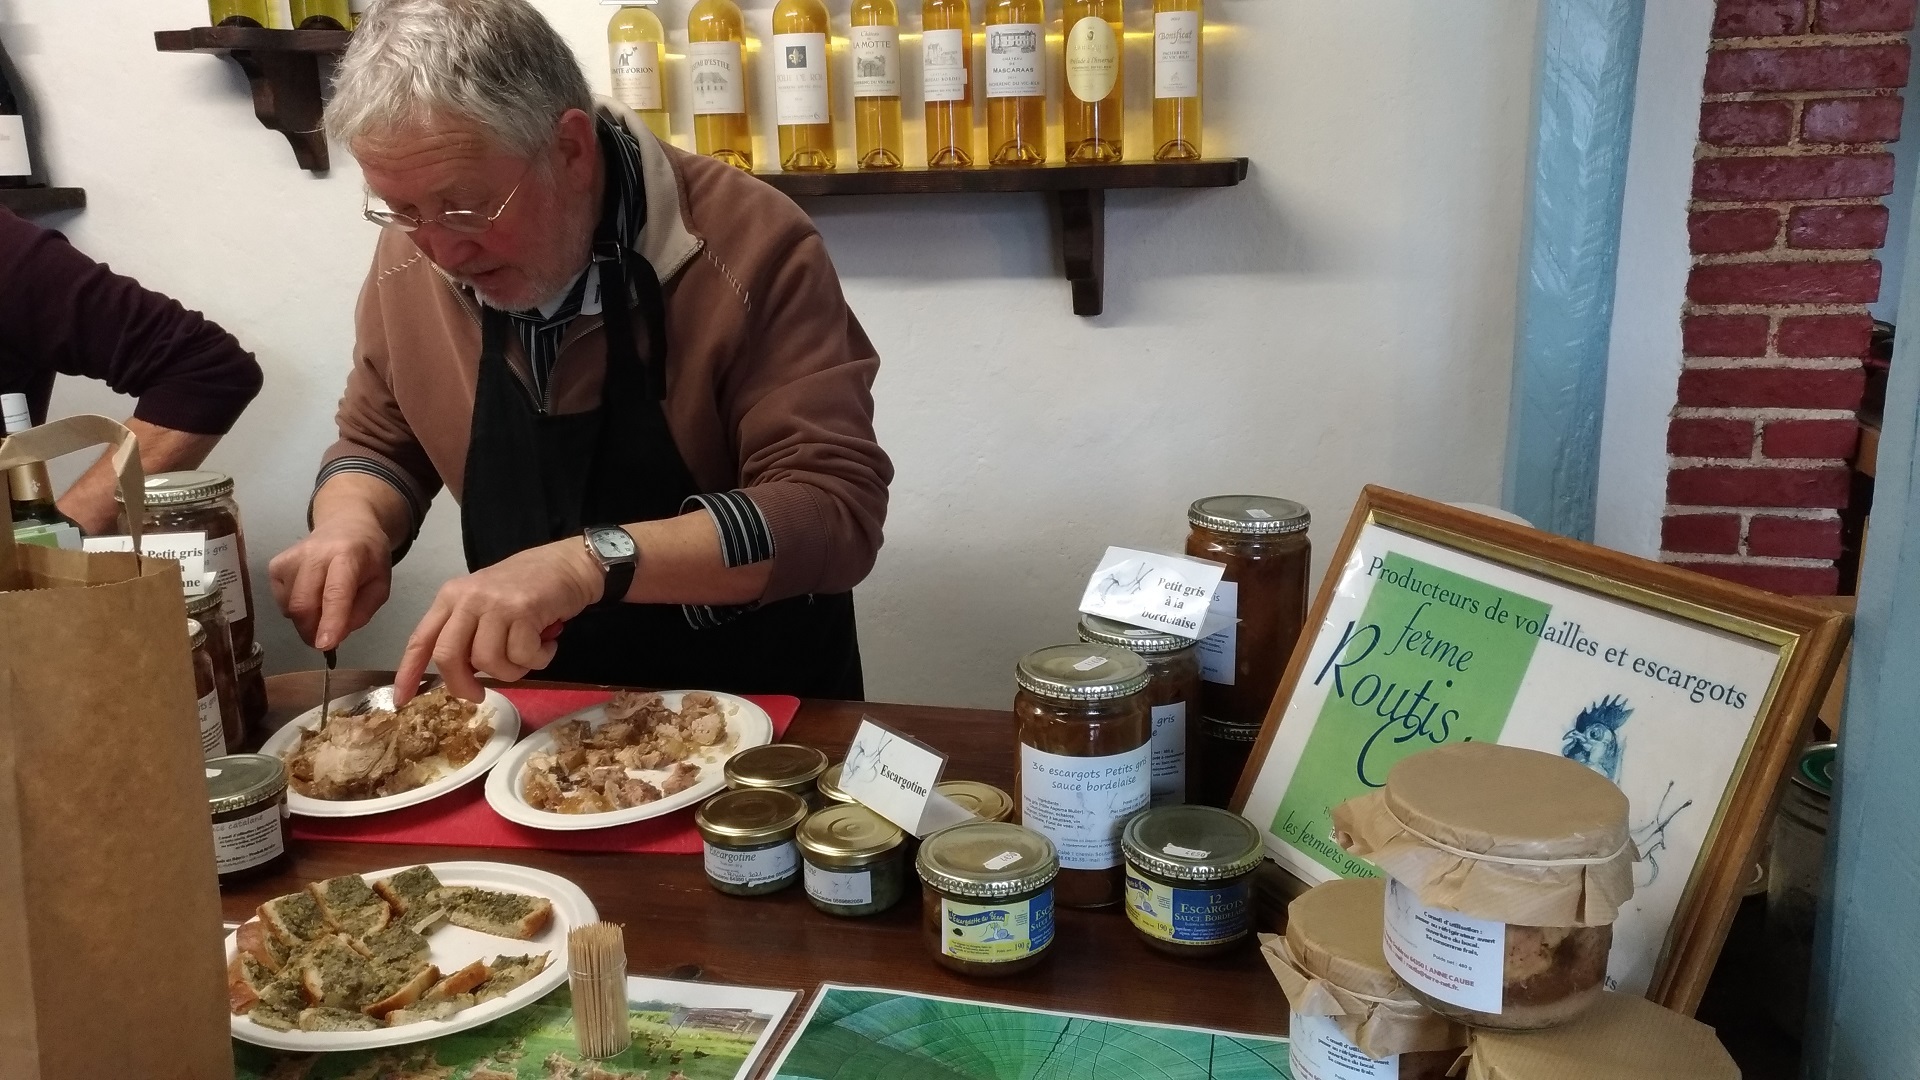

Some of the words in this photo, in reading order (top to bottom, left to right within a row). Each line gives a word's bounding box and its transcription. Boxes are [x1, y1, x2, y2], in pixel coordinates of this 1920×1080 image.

[862, 40, 891, 48] MOTTE
[147, 549, 177, 560] Petit
[179, 546, 203, 560] gris
[1184, 584, 1206, 598] gris
[1164, 596, 1172, 606] à
[1173, 597, 1184, 610] la
[1366, 556, 1479, 616] Producteurs
[1483, 597, 1510, 625] de
[1513, 607, 1599, 658] volailles
[1604, 645, 1629, 668] et
[1632, 657, 1748, 711] escargots
[1384, 603, 1474, 673] ferme
[1156, 714, 1175, 728] gris
[1032, 762, 1045, 773] 36
[1048, 766, 1101, 782] escargots
[1105, 764, 1134, 779] Petits
[880, 764, 928, 798] Escargotine
[1052, 780, 1081, 792] sauce
[1086, 775, 1137, 792] bordelaise
[1282, 810, 1298, 836] les
[1293, 820, 1344, 864] fermiers
[710, 846, 756, 863] Escargotine
[1209, 894, 1222, 904] 12
[1180, 900, 1244, 914] ESCARGOTS
[1174, 912, 1200, 922] SAUCE
[1157, 922, 1168, 932] 190
